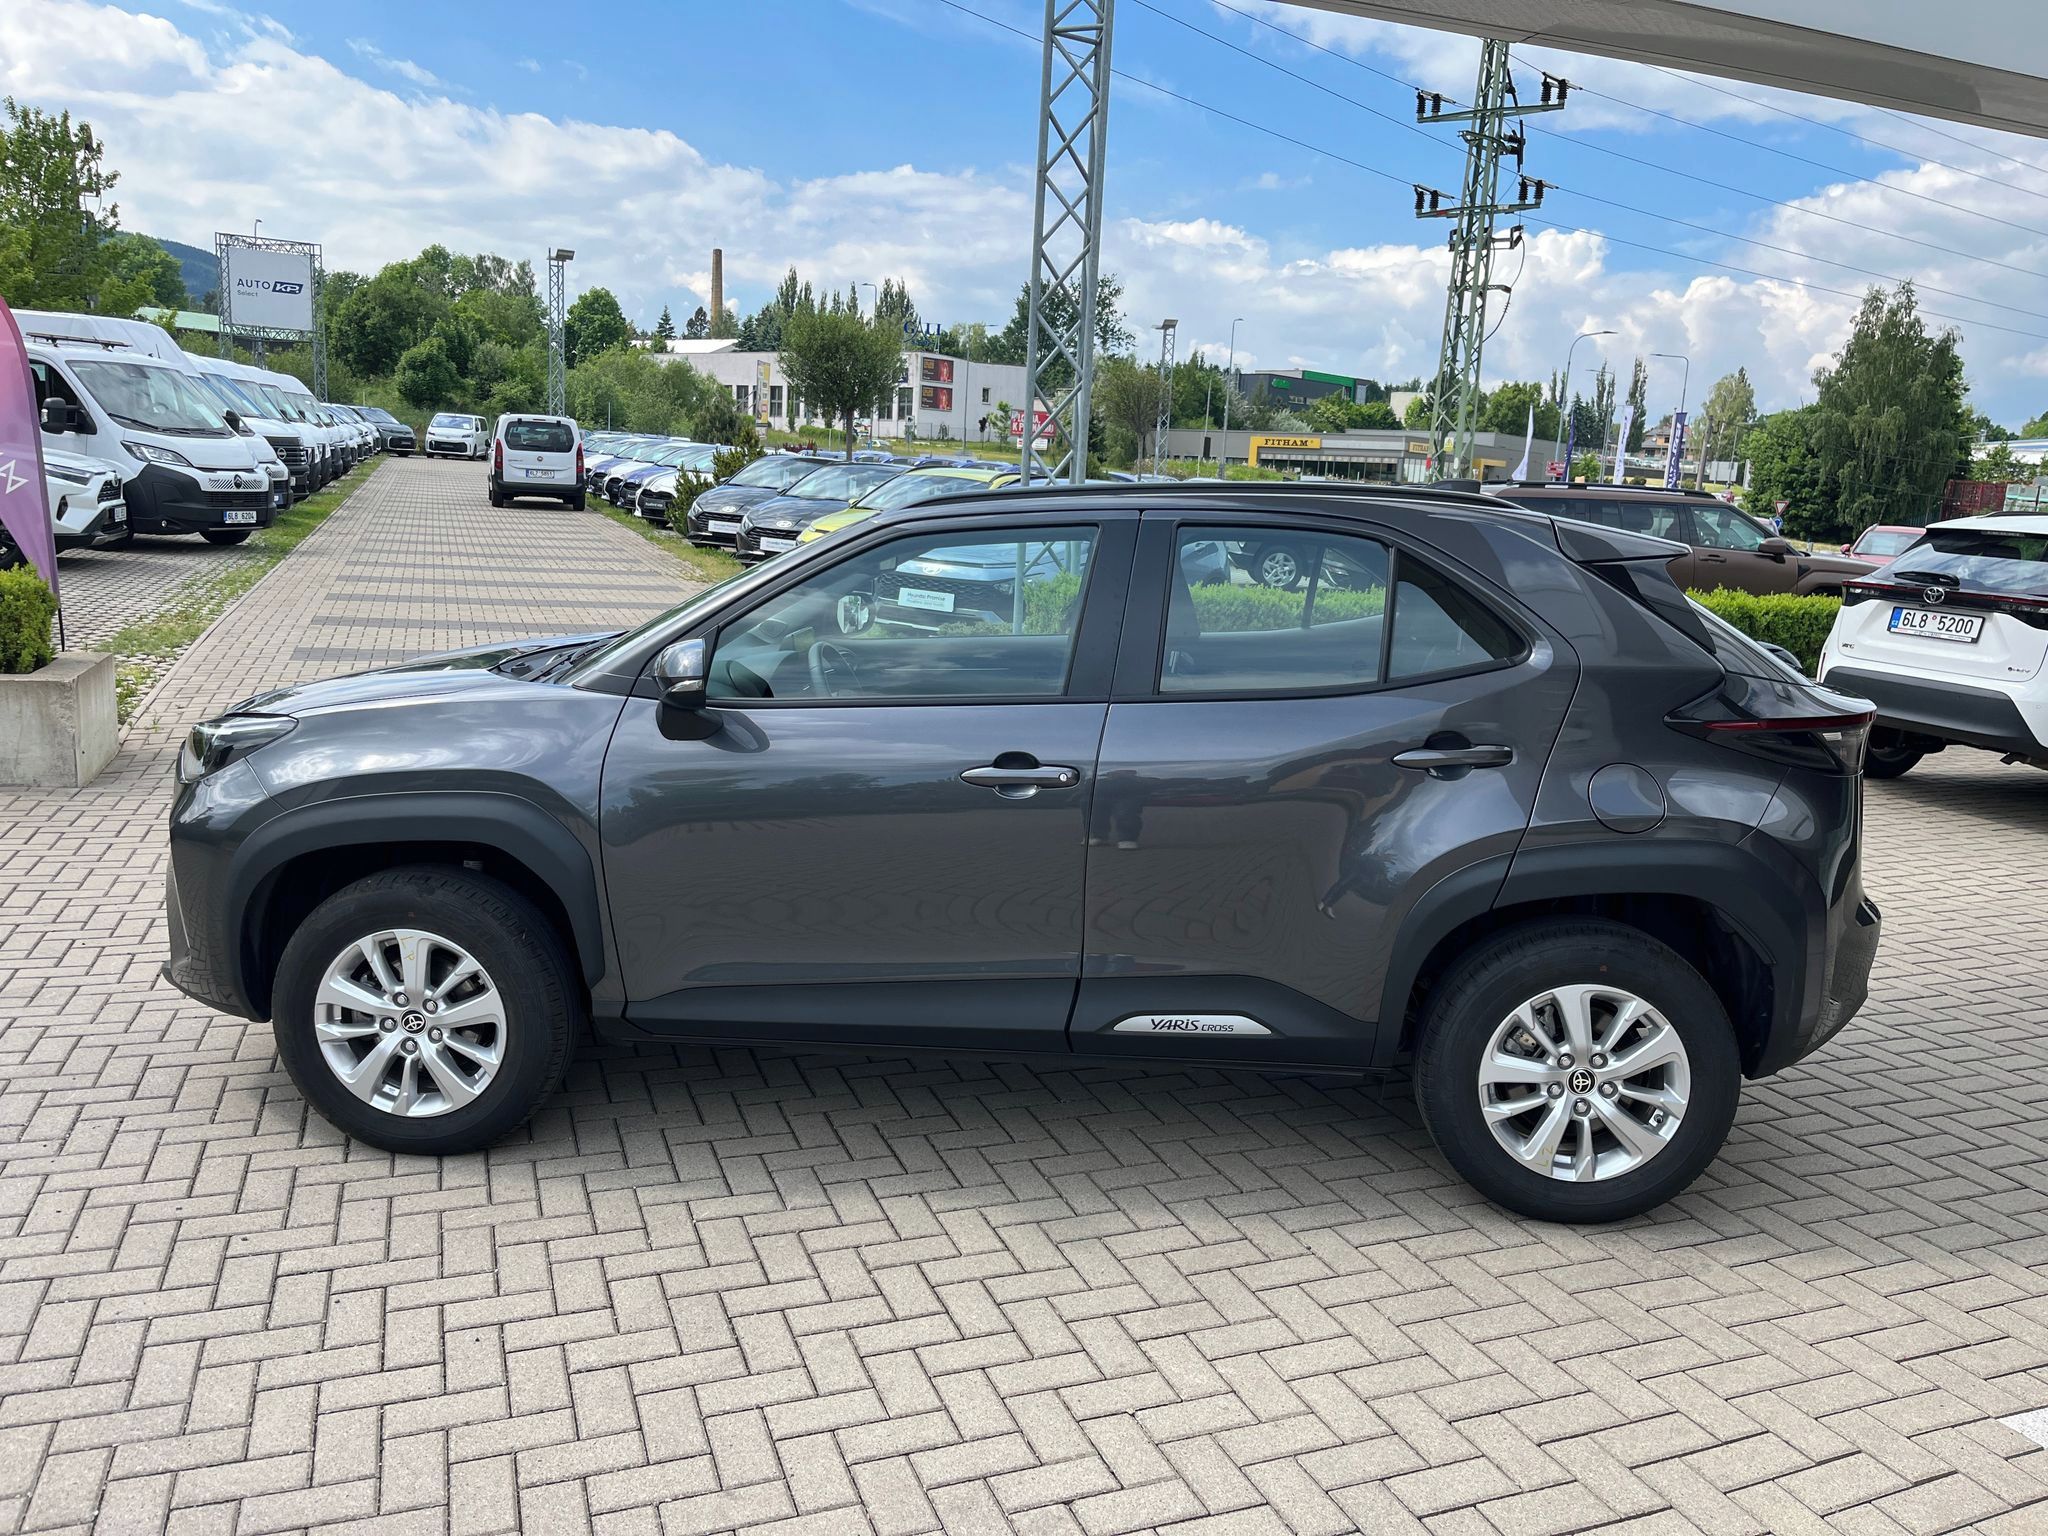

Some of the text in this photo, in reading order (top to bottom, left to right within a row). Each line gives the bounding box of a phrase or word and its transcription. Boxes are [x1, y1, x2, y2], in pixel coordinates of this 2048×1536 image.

[237, 278, 271, 290] AUTO
[237, 289, 258, 297] Select
[1264, 438, 1308, 447] FITHAM
[227, 512, 255, 520] 6L8 6204
[926, 594, 946, 602] Promise
[1902, 612, 1928, 628] 6L8
[1937, 616, 1974, 634] 5200
[1201, 1024, 1234, 1032] CROSS
